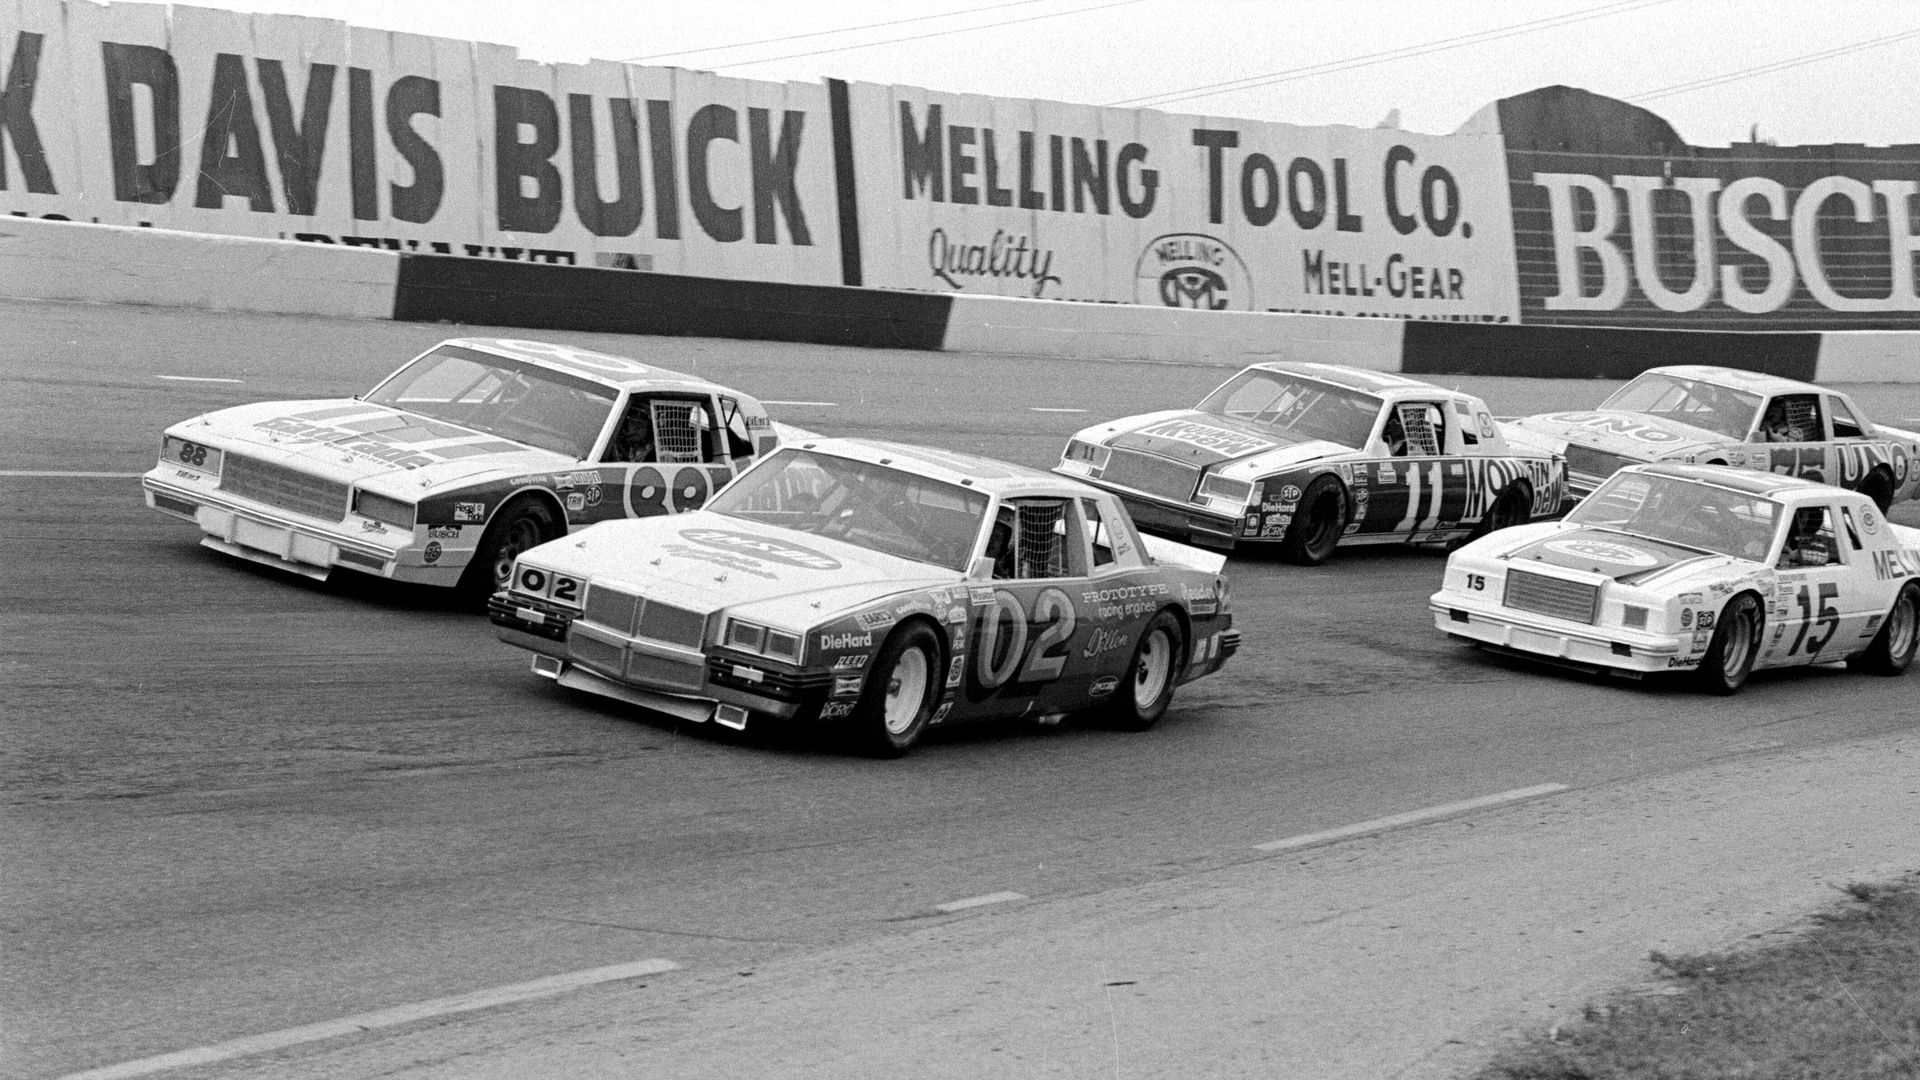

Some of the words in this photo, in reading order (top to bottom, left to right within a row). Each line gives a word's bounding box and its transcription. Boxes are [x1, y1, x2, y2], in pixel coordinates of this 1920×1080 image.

[102, 41, 443, 223] DAVIS
[494, 85, 813, 247] BUICK
[899, 100, 1159, 220] MELLING
[1192, 129, 1363, 233] TOOL
[1385, 145, 1473, 239] CO.
[929, 228, 1062, 297] Quality
[1303, 248, 1464, 302] MELL-GEAR
[179, 442, 207, 466] 88
[586, 487, 600, 502] STP
[1283, 487, 1298, 499] STP
[1393, 461, 1443, 531] 11
[1262, 502, 1296, 513] DieHard
[428, 530, 460, 539] BUSCH
[1082, 583, 1169, 604] PROTOTYPE
[1466, 574, 1485, 592] 15
[1125, 600, 1157, 619] engines
[1788, 582, 1840, 657] 15
[820, 631, 873, 650] DieHard
[976, 586, 1078, 689] 02
